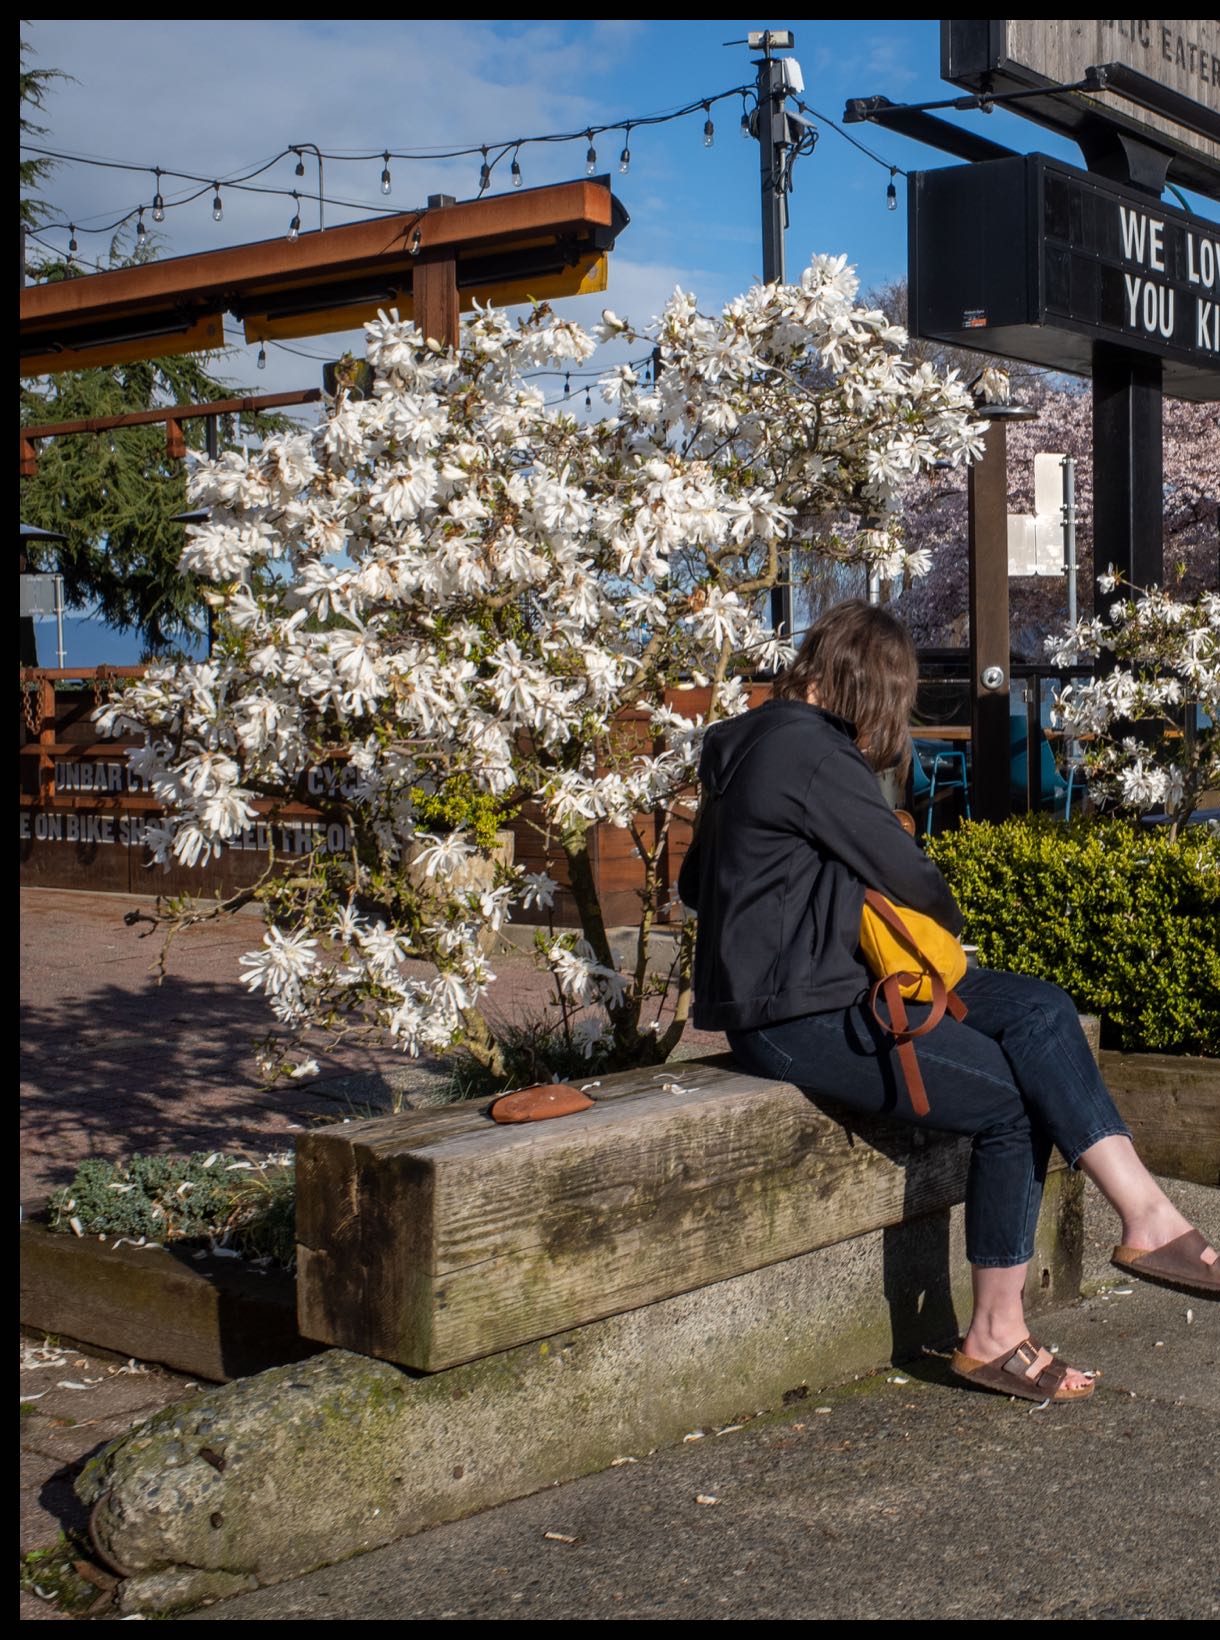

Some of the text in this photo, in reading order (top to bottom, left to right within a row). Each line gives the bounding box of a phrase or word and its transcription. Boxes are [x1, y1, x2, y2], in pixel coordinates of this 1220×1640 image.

[1120, 206, 1165, 272] WE
[1124, 273, 1174, 338] YOU
[42, 762, 122, 791] UNBAR
[35, 813, 62, 841] ON
[66, 814, 115, 843] BIKE
